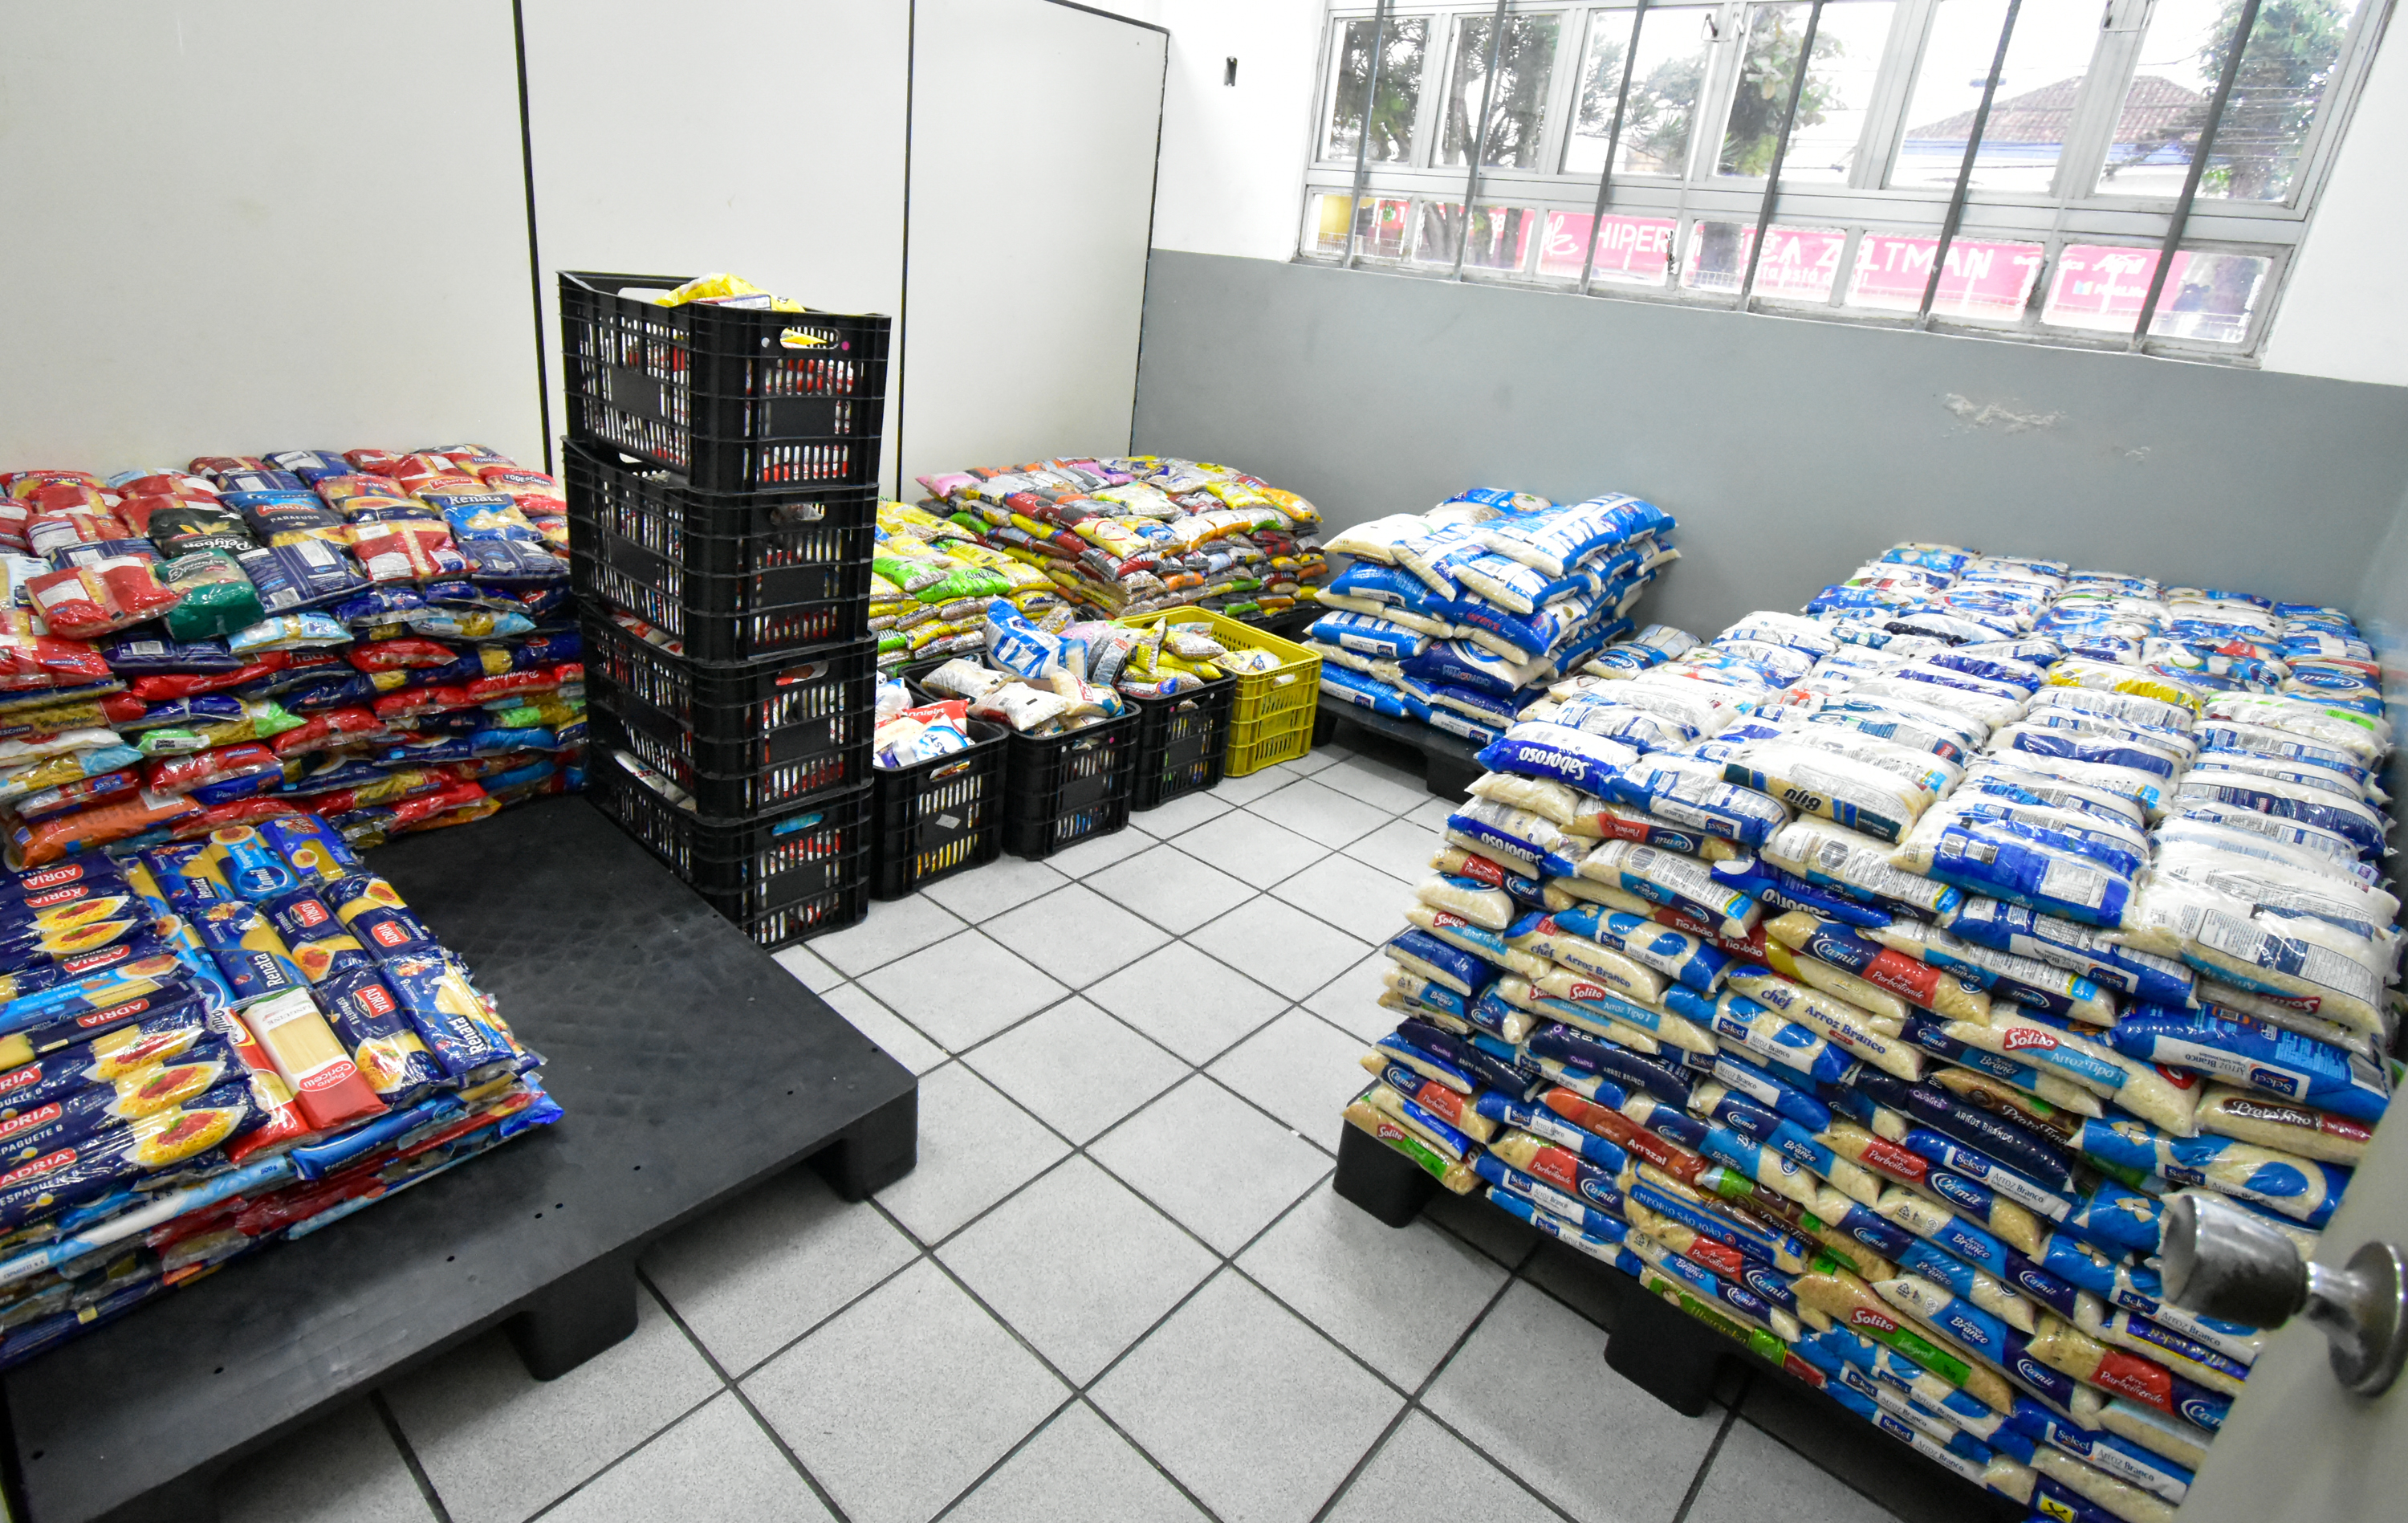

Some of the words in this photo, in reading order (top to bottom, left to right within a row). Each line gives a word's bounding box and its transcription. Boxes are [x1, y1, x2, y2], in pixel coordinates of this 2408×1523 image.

[504, 474, 551, 486] TODESCHINI
[449, 495, 503, 505] Renata
[270, 515, 320, 523] PARAFUSO
[181, 538, 252, 551] Petybon
[1601, 654, 1634, 666] Camil
[2298, 673, 2356, 690] Camil
[1470, 731, 1487, 743] Select
[1519, 746, 1593, 781] Saboroso
[1782, 788, 1823, 811] Biju
[1705, 823, 1733, 836] Select
[1481, 832, 1543, 866] Saboroso
[1653, 833, 1682, 850] Camil
[26, 867, 78, 886] ADRIA
[250, 867, 278, 891] Camil
[30, 886, 83, 906] ADRIA
[192, 878, 214, 899] Renata
[1511, 879, 1537, 897] Camil
[275, 911, 291, 930] ESPAGUETE
[300, 902, 322, 923] ADRIA
[1437, 914, 1466, 926] Solito
[377, 923, 401, 944] ADRIA
[1461, 928, 1481, 943] Arroz
[1676, 918, 1690, 930] Tio
[1690, 922, 1714, 939] João
[1531, 943, 1556, 959] chef
[1602, 934, 1624, 949] Select
[1727, 939, 1739, 950] Tio
[1738, 942, 1763, 958] João
[67, 947, 124, 968] ADRIA
[1628, 945, 1645, 960] Arroz
[1645, 951, 1665, 967] Branco
[1819, 939, 1859, 967] Camil
[254, 952, 285, 988] Renata
[1565, 953, 1593, 975] Arroz
[1596, 965, 1631, 988] Branco
[1942, 963, 1982, 983] Branco
[2092, 970, 2124, 988] Select
[1571, 986, 1603, 1000] Solito
[1871, 970, 1925, 1000] Parboilizado
[364, 988, 389, 1012] ADRIA
[1430, 991, 1454, 1007] Branco
[1761, 988, 1793, 1011] chef
[2011, 988, 2047, 1006] Camil
[83, 1002, 143, 1025] ADRIA
[336, 997, 357, 1021] ESPAGUETE
[1473, 1010, 1495, 1026] Camil
[1604, 1000, 1625, 1015] Arroz
[1626, 1006, 1644, 1020] Tipo
[449, 1016, 487, 1055] Renata
[1719, 1020, 1745, 1041] Select
[1804, 1004, 1841, 1029] Arroz
[1841, 1024, 1886, 1054] Branco
[1921, 1030, 1947, 1049] Camil
[1751, 1035, 1770, 1051] Arroz
[1770, 1042, 1791, 1061] Branco
[2006, 1032, 2055, 1049] Solito
[1520, 1057, 1541, 1073] Select
[1570, 1055, 1594, 1069] Qualitá
[1690, 1053, 1714, 1067] Select
[2051, 1053, 2085, 1067] Arroz
[2085, 1060, 2114, 1078] Tipo
[2185, 1053, 2217, 1069] Branco
[2218, 1061, 2246, 1076] Arroz
[303, 1063, 352, 1088] Coricelli
[317, 1072, 346, 1088] Pietro
[1392, 1069, 1418, 1091] Camil
[1603, 1066, 1621, 1081] ARROZ
[1621, 1073, 1645, 1087] BRANCO
[1717, 1064, 1737, 1078] Arroz
[1737, 1073, 1758, 1090] Branco
[2252, 1072, 2294, 1093] Select
[1422, 1093, 1455, 1118] Parboilizado
[1912, 1089, 1946, 1110] Qualitá
[1511, 1110, 1531, 1124] Select
[1733, 1114, 1758, 1130] Camil
[2232, 1100, 2276, 1118] Prato
[2276, 1106, 2312, 1126] Fino
[1378, 1126, 1403, 1142] Solito
[1662, 1126, 1686, 1142] Camil
[1954, 1110, 1981, 1127] ARROZ
[1981, 1122, 2014, 1143] BRANCO
[2003, 1105, 2040, 1130] Prato
[2040, 1122, 2067, 1145] Fino
[2327, 1122, 2370, 1138] BRANCO
[1626, 1138, 1668, 1166] Arrozal
[1711, 1150, 1742, 1171] Branco
[1784, 1138, 1816, 1163] Branco
[1, 1154, 69, 1184] ADRIA
[1533, 1162, 1572, 1184] Parboilizado
[1955, 1153, 1987, 1175] Select
[1511, 1175, 1531, 1189] Select
[1584, 1180, 1617, 1204] Camil
[1938, 1177, 1982, 1206] Camil
[1991, 1171, 2016, 1190] Arroz
[2015, 1181, 2044, 1203] Branco
[1535, 1189, 1550, 1201] Arroz
[1633, 1189, 1675, 1216] EMPÓRIO
[1677, 1208, 1697, 1228] SÃO
[1698, 1217, 1721, 1241] JOÃO
[1538, 1220, 1557, 1235] Select
[1563, 1234, 1577, 1244] Arroz
[1579, 1241, 1597, 1253] Branco
[1859, 1230, 1889, 1250] Camil
[1951, 1232, 1992, 1259] Branco
[1674, 1257, 1705, 1281] Branco
[1690, 1246, 1735, 1274] Parboilizado
[1916, 1260, 1953, 1286] Branco
[1751, 1273, 1789, 1301] Camil
[2026, 1273, 2056, 1297] Camil
[1733, 1289, 1758, 1308] Camil
[2121, 1293, 2158, 1313] Select
[1853, 1309, 1896, 1331] Solito
[1950, 1316, 1989, 1345] Branco
[2160, 1309, 2186, 1326] Arroz
[2186, 1324, 2222, 1348] Branco
[1850, 1374, 1875, 1395] Select
[1881, 1374, 1909, 1391] Select
[2025, 1362, 2056, 1387] Camil
[2125, 1374, 2148, 1387] Arroz
[2100, 1370, 2165, 1403] Parboilizado
[1881, 1397, 1902, 1411] Arroz
[1902, 1409, 1927, 1427] Branco
[1915, 1394, 1936, 1408] Arroz
[1937, 1407, 1963, 1425] Branco
[1883, 1419, 1911, 1440] Select
[2056, 1428, 2090, 1452] Select
[1918, 1440, 1938, 1456] Arroz
[1939, 1453, 1963, 1472] Branco
[2097, 1448, 2122, 1468] Arroz
[2123, 1459, 2154, 1482] Branco
